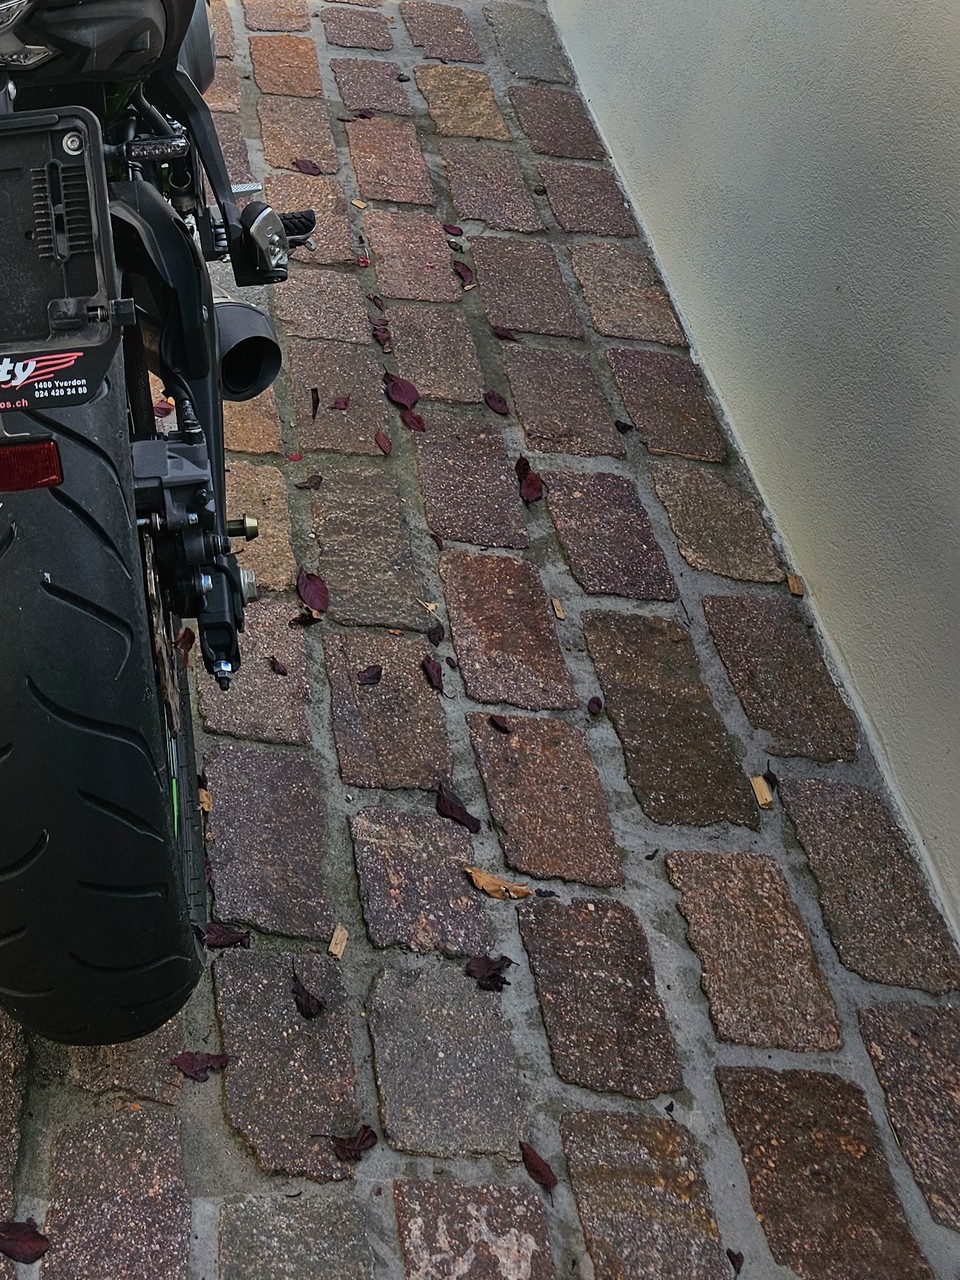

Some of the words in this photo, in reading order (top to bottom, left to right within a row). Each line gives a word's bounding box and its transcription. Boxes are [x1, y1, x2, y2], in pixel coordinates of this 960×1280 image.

[34, 381, 52, 389] 1400
[54, 379, 87, 388] Yverdon
[34, 390, 49, 398] 024
[51, 389, 65, 397] 420
[78, 386, 88, 394] 80
